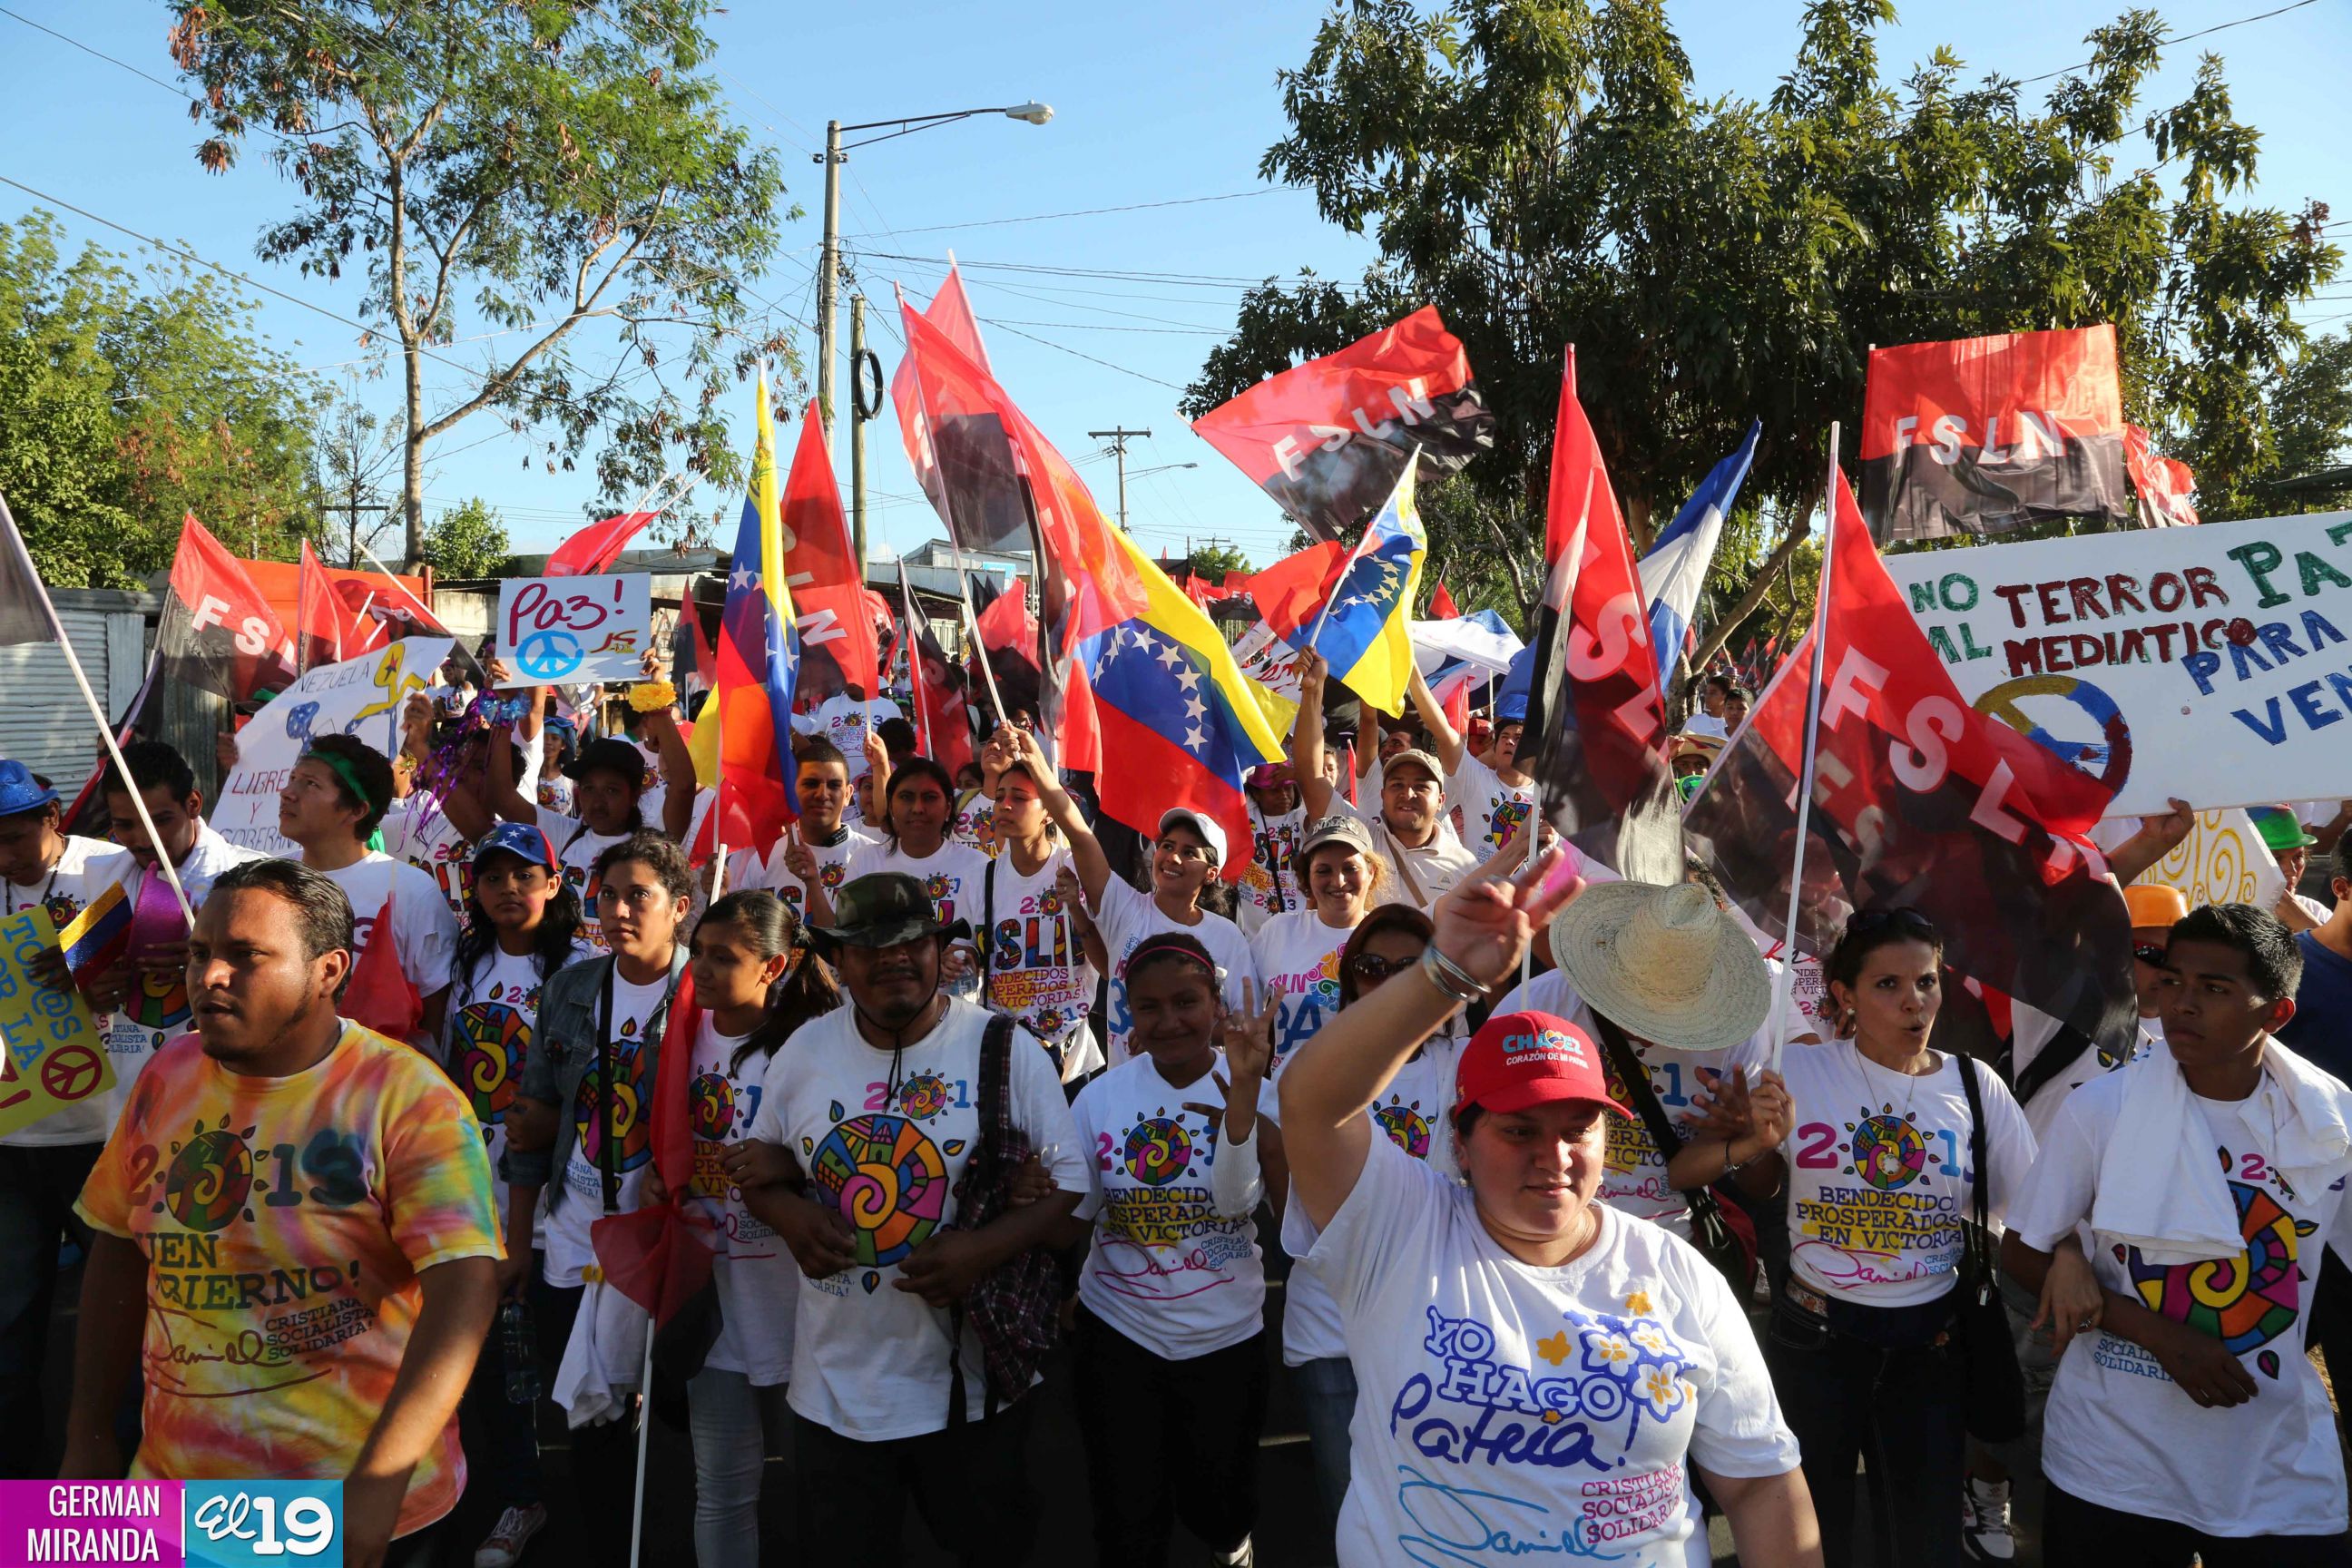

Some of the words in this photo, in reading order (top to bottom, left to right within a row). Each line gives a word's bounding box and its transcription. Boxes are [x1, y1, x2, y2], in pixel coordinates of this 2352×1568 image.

[1896, 410, 2067, 468] FSLN
[508, 578, 625, 648] Paz!
[1908, 572, 1979, 614] NO
[1992, 565, 2230, 629] TERROR
[1927, 622, 1993, 665] AL
[2002, 616, 2258, 678] MEDIATICO
[2180, 609, 2348, 696] PARA
[287, 661, 370, 695] NEZUELA
[231, 769, 291, 795] LIBRE
[1, 1012, 45, 1071] LA
[1506, 1051, 1547, 1065] CORAZÓN
[1547, 1053, 1560, 1061] DE
[1796, 1202, 1962, 1231] PROSPERADOS
[1819, 1186, 1956, 1212] BENDECIDO
[1819, 1225, 1854, 1246] EN
[1424, 1305, 1495, 1361] YO
[1436, 1356, 1627, 1423] HAGO
